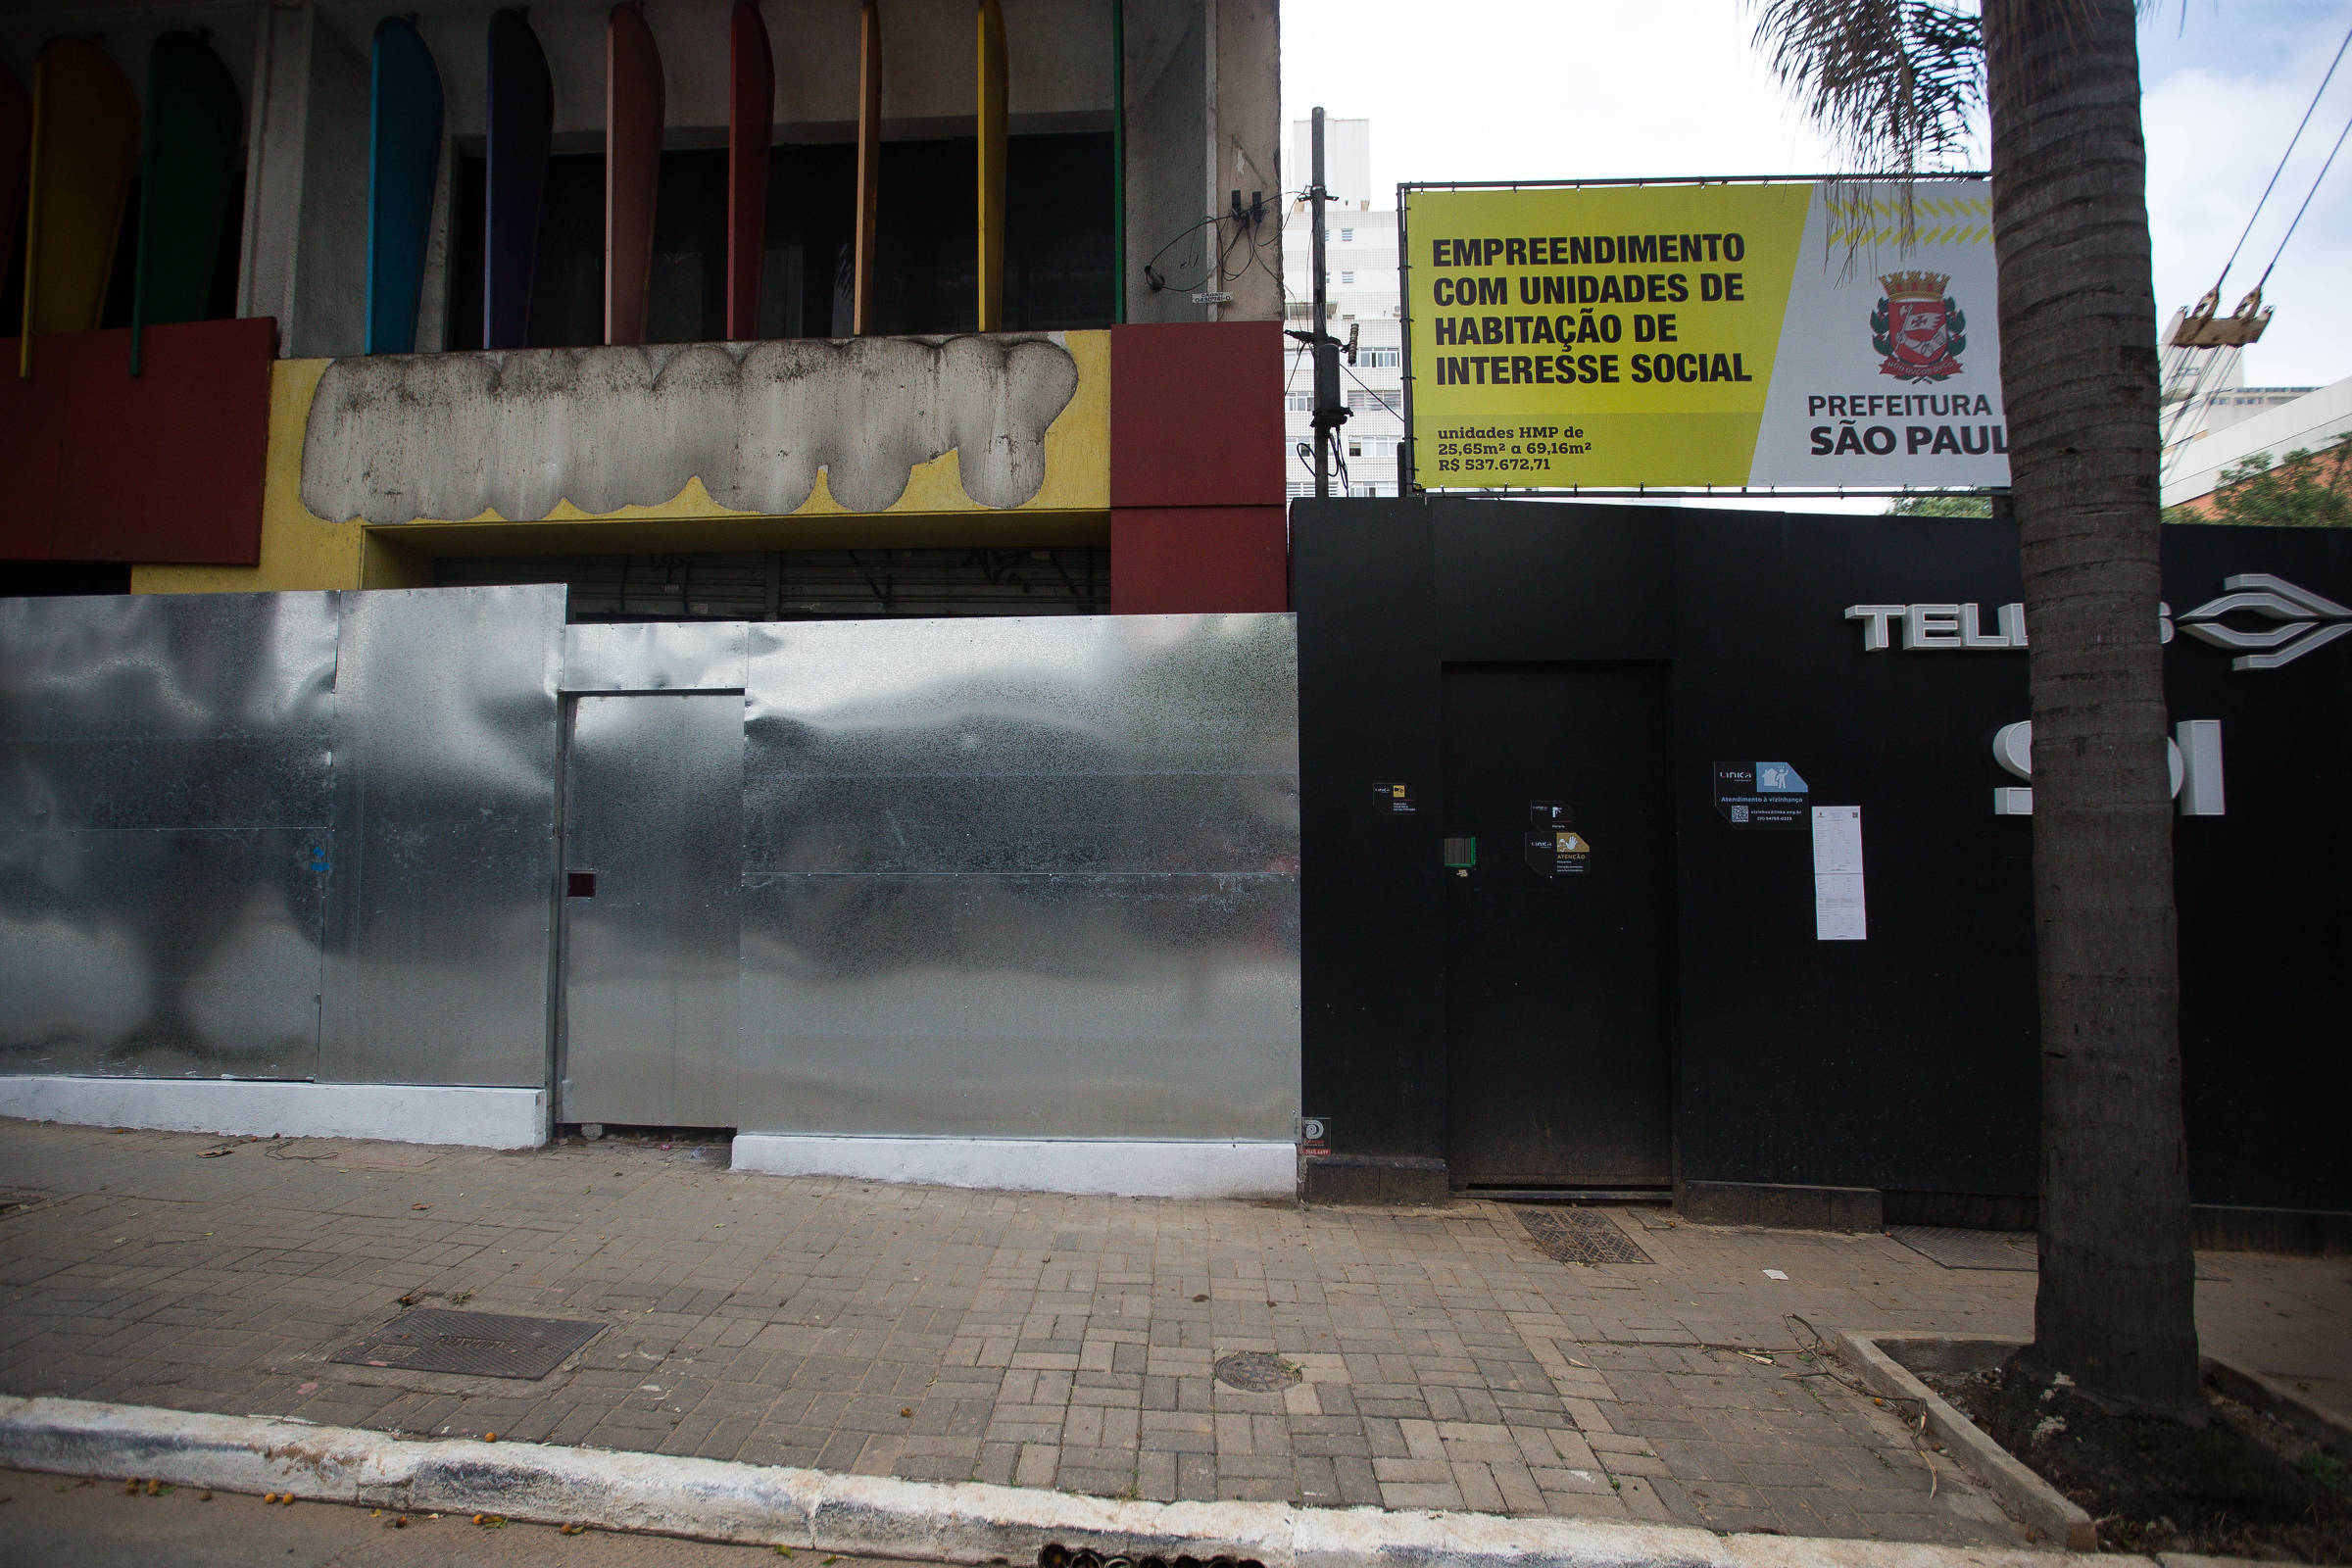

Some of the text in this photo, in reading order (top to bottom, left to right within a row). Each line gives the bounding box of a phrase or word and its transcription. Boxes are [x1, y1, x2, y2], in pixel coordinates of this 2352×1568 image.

[1433, 232, 1745, 267] EMPREENDIMENTO
[1433, 272, 1744, 306] COM UNIDADES DE
[1435, 308, 1678, 352] HABITAÇÃO DE
[1436, 353, 1753, 385] INTERESSE SOCIAL
[1808, 394, 1992, 416] PREFEITURA
[1438, 426, 1584, 439] unidades HMP de
[1810, 419, 2009, 456] SÃO PAUL
[1438, 442, 1592, 456] 25,65m² a 69,16m²
[1439, 458, 1550, 472] R$ 537.672,71
[1769, 796, 1803, 805] vizinhança
